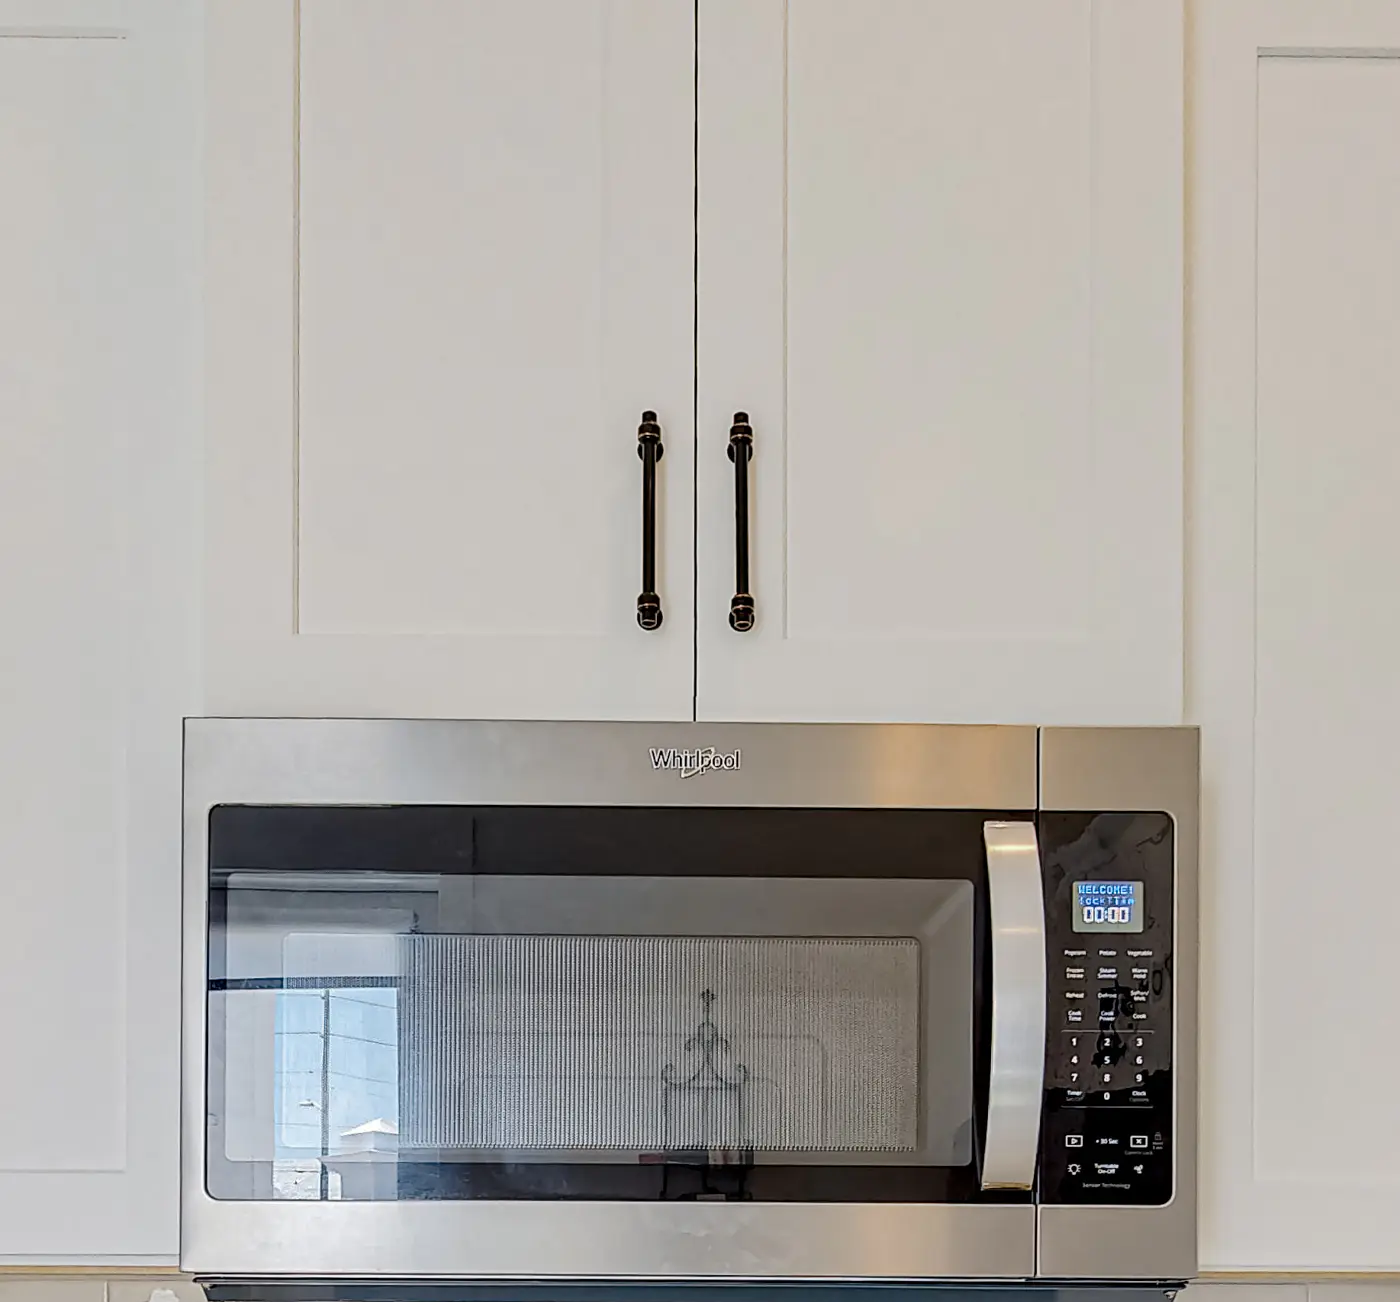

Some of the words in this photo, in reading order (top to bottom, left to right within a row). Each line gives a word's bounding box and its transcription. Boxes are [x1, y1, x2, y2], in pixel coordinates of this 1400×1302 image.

[649, 748, 740, 777] Whirlpool
[1078, 885, 1133, 894] WELCOME!
[1083, 906, 1129, 923] 00:00
[1072, 1038, 1077, 1046] 1
[1104, 1038, 1110, 1046] 2
[1136, 1038, 1142, 1046] 3
[1071, 1056, 1078, 1064] 4
[1104, 1056, 1110, 1064] 5
[1136, 1056, 1142, 1064] 6
[1071, 1074, 1078, 1082] 7
[1104, 1074, 1110, 1082] 8
[1136, 1074, 1142, 1082] 9
[1104, 1092, 1110, 1100] 0
